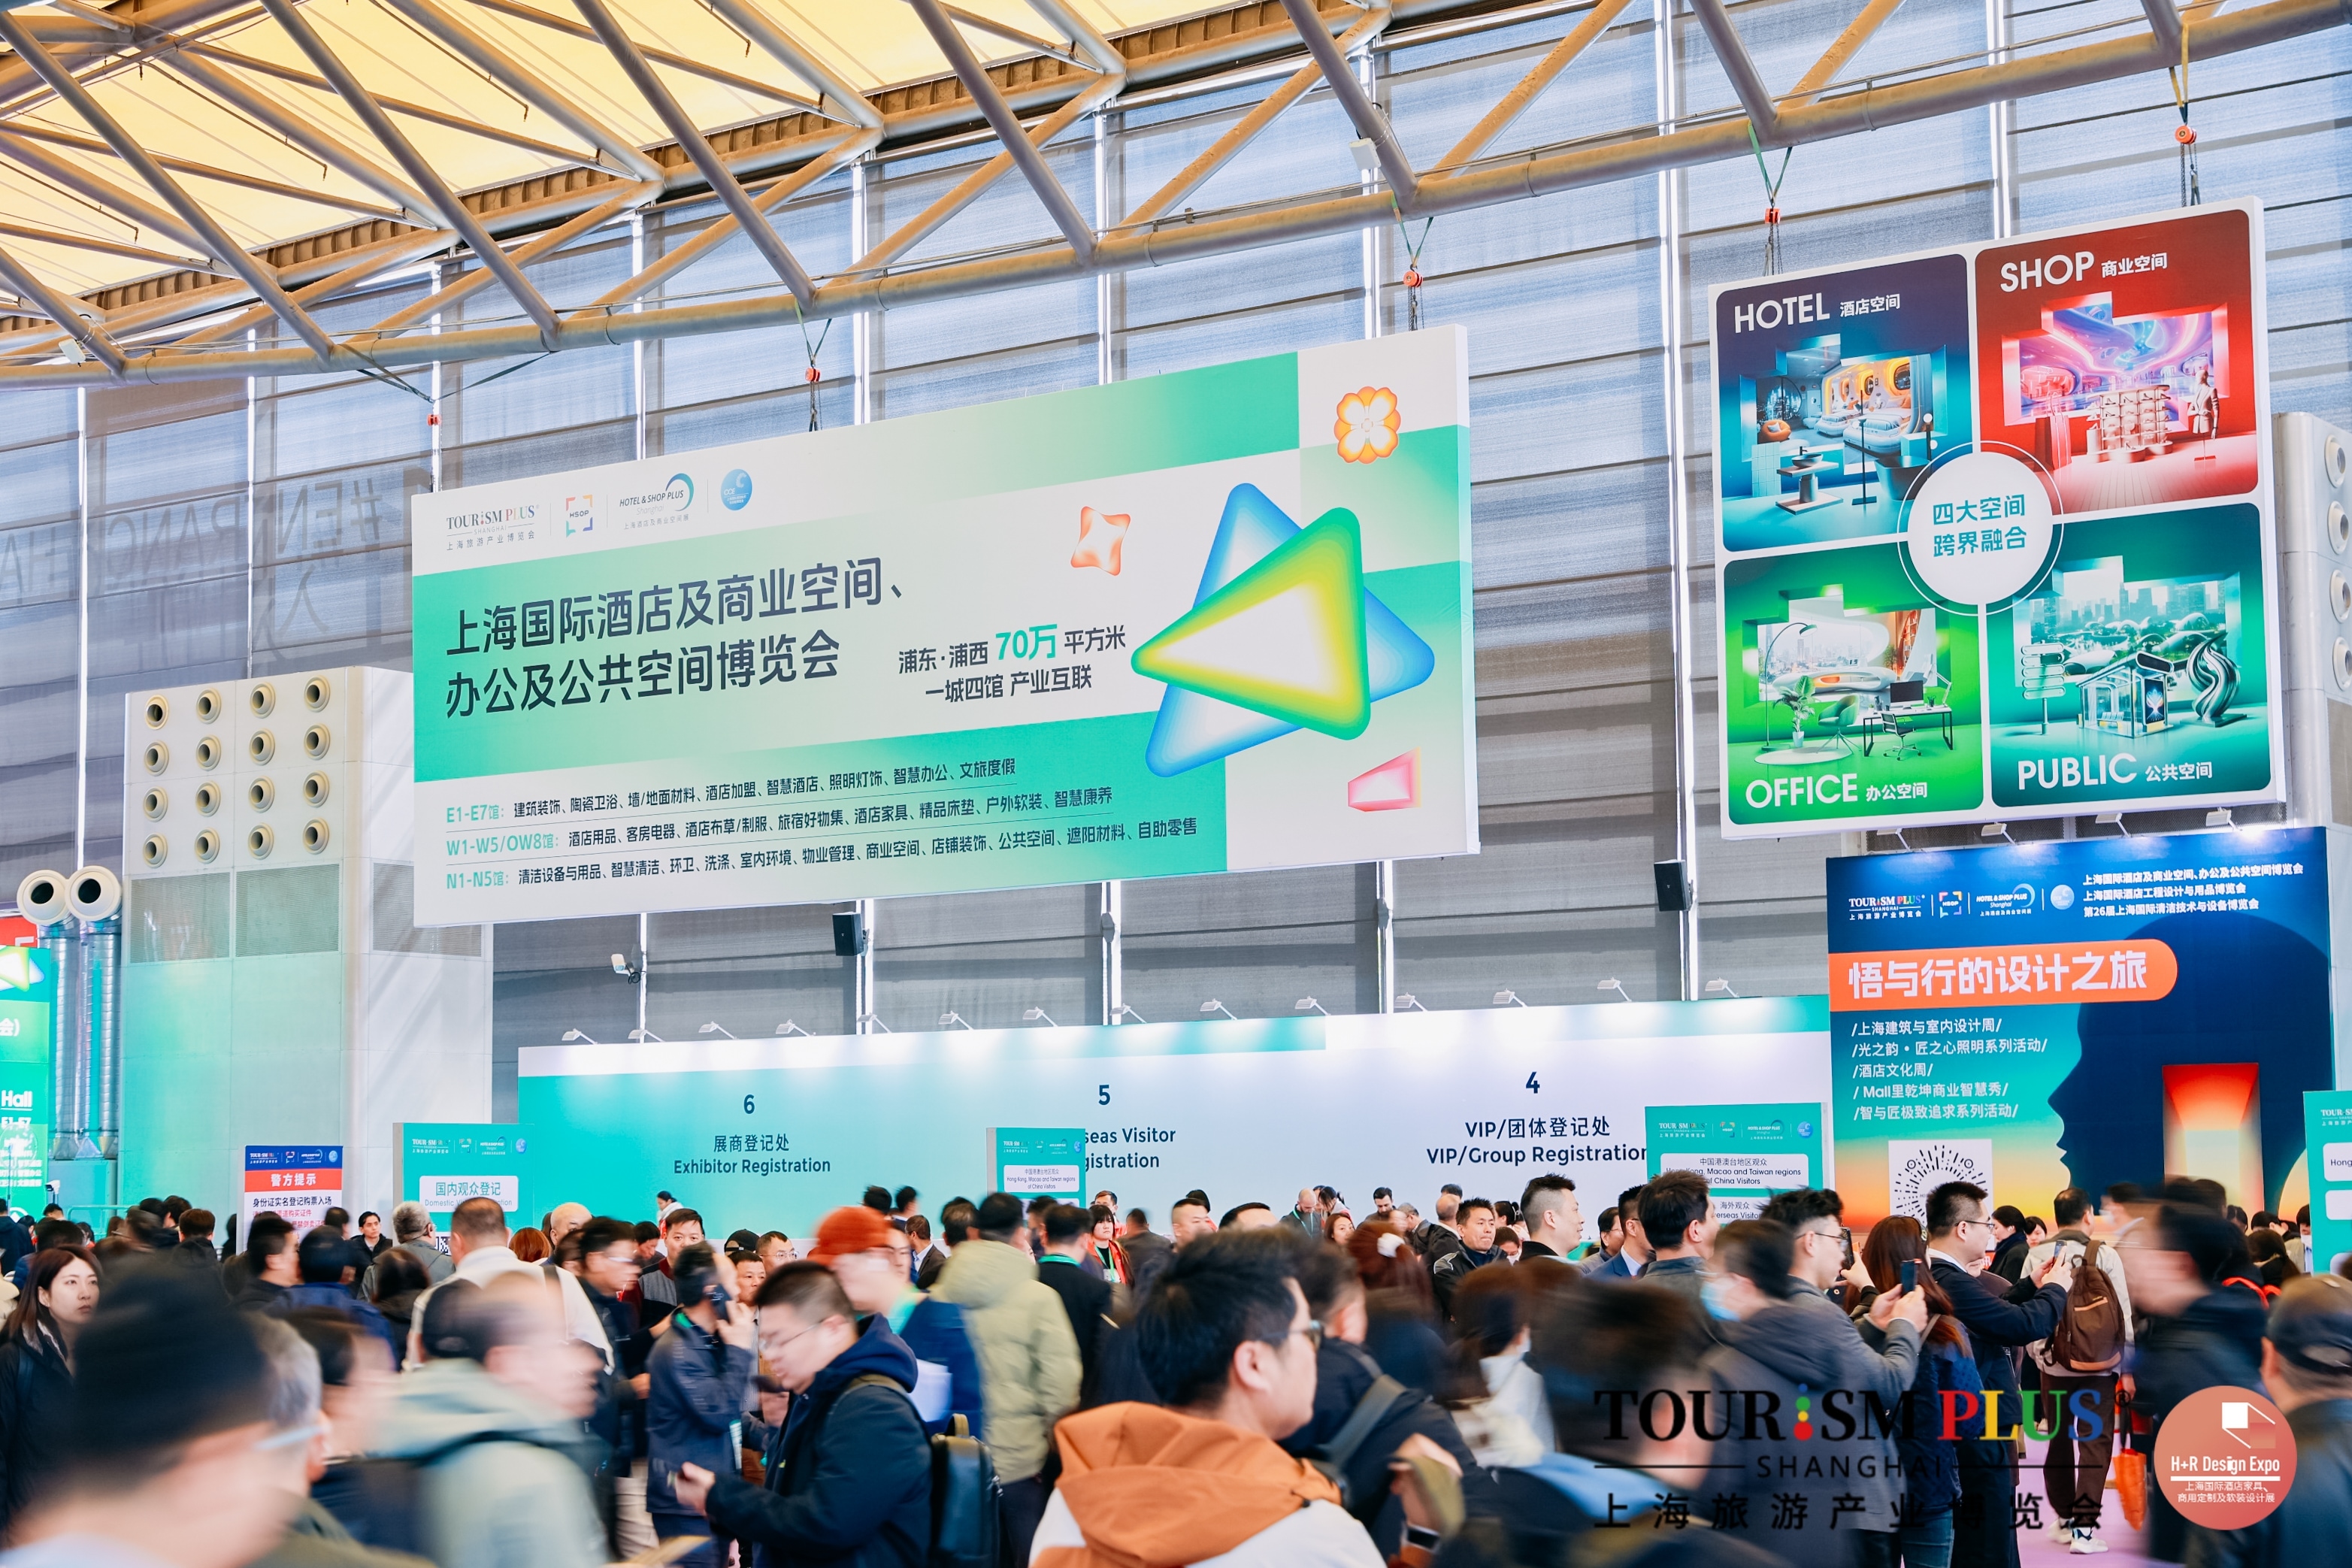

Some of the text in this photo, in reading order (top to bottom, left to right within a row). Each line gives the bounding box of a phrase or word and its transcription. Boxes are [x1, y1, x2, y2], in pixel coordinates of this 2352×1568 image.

[2000, 250, 2094, 293] SHOP
[2101, 252, 2168, 278] 商业空间
[1734, 292, 1830, 334] HOTEL
[1839, 293, 1901, 318] 酒店空间
[619, 489, 684, 507] HOTEL & SHOP PLUS
[505, 505, 535, 521] PLUS
[569, 510, 589, 518] HSOP
[1933, 493, 2026, 525] 四大空间
[474, 525, 507, 535] SHANGHAI
[446, 530, 535, 551] 上海旅游产业博览会
[1933, 526, 2027, 558] 跨界融合
[446, 556, 903, 655] 上海国际酒店及商业空间、
[898, 623, 1126, 674] 浦东·浦西 70万 平方米
[445, 629, 840, 718] 办公及公共空间博览会
[925, 664, 1092, 703] 一城四馆 产业互联
[2018, 752, 2138, 790] PUBLIC
[2145, 760, 2213, 782] 公共空间
[1745, 773, 1858, 809] OFFICE
[1865, 782, 1929, 802] 办公空间
[2082, 862, 2304, 886] 上海国际酒店及商业空间、办公及公共空间博览会
[1896, 894, 1921, 904] PLUS
[2014, 892, 2027, 901] PLUS
[2083, 882, 2247, 902] 上海国际酒店工程设计与用品博览会
[2084, 898, 2260, 918] 第26届上海国际清洁技术与设备博览会
[1848, 949, 2147, 999] 悟与行的设计之旅
[1851, 1018, 2002, 1037] /上海建筑与室内设计周/
[1852, 1063, 1933, 1079] /酒店文化周/
[1525, 1071, 1540, 1094] 4
[1, 1090, 33, 1107] Hall
[743, 1094, 755, 1115] 6
[1098, 1085, 1111, 1106] 5
[1854, 1103, 2018, 1121] /智与匠极致追求系列活动/
[1122, 1127, 1176, 1143] Visitor
[1465, 1115, 1610, 1140] VIP/团体登记处
[713, 1133, 790, 1153] 展商登记处
[674, 1157, 831, 1176] Exhibitor Registration
[1085, 1152, 1159, 1173] istration
[1427, 1147, 1527, 1166] VIP/Group
[1700, 1158, 1767, 1167] 中国港澳台地区观众
[271, 1173, 316, 1187] 警方提示
[1775, 1168, 1801, 1176] regions
[435, 1182, 501, 1197] 国内观众登记
[253, 1197, 331, 1208] 身份证实名登记购票入场
[1720, 1201, 1750, 1209] 海外观众
